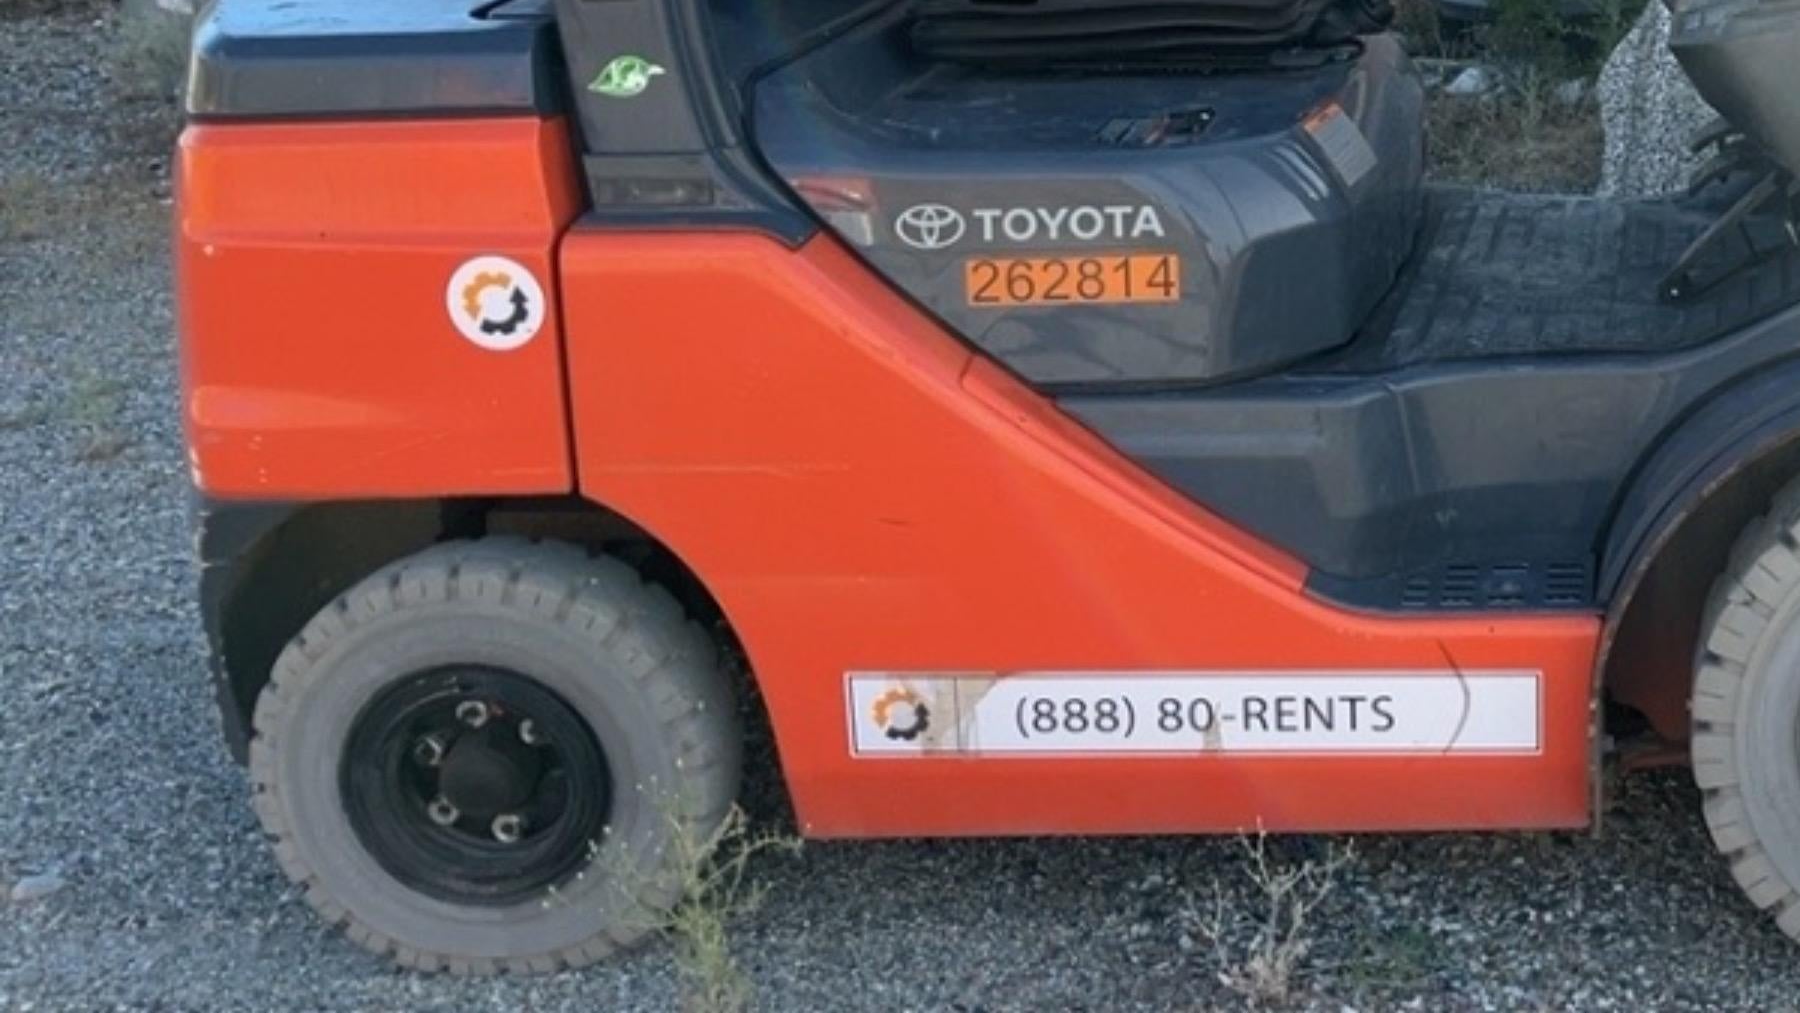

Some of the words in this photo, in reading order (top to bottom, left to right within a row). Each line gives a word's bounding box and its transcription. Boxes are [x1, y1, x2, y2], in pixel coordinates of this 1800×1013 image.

[972, 205, 1166, 241] TOYOTA
[971, 256, 1176, 303] 262814
[1016, 696, 1136, 738] (888)
[1157, 696, 1395, 733] 80-RENTS
